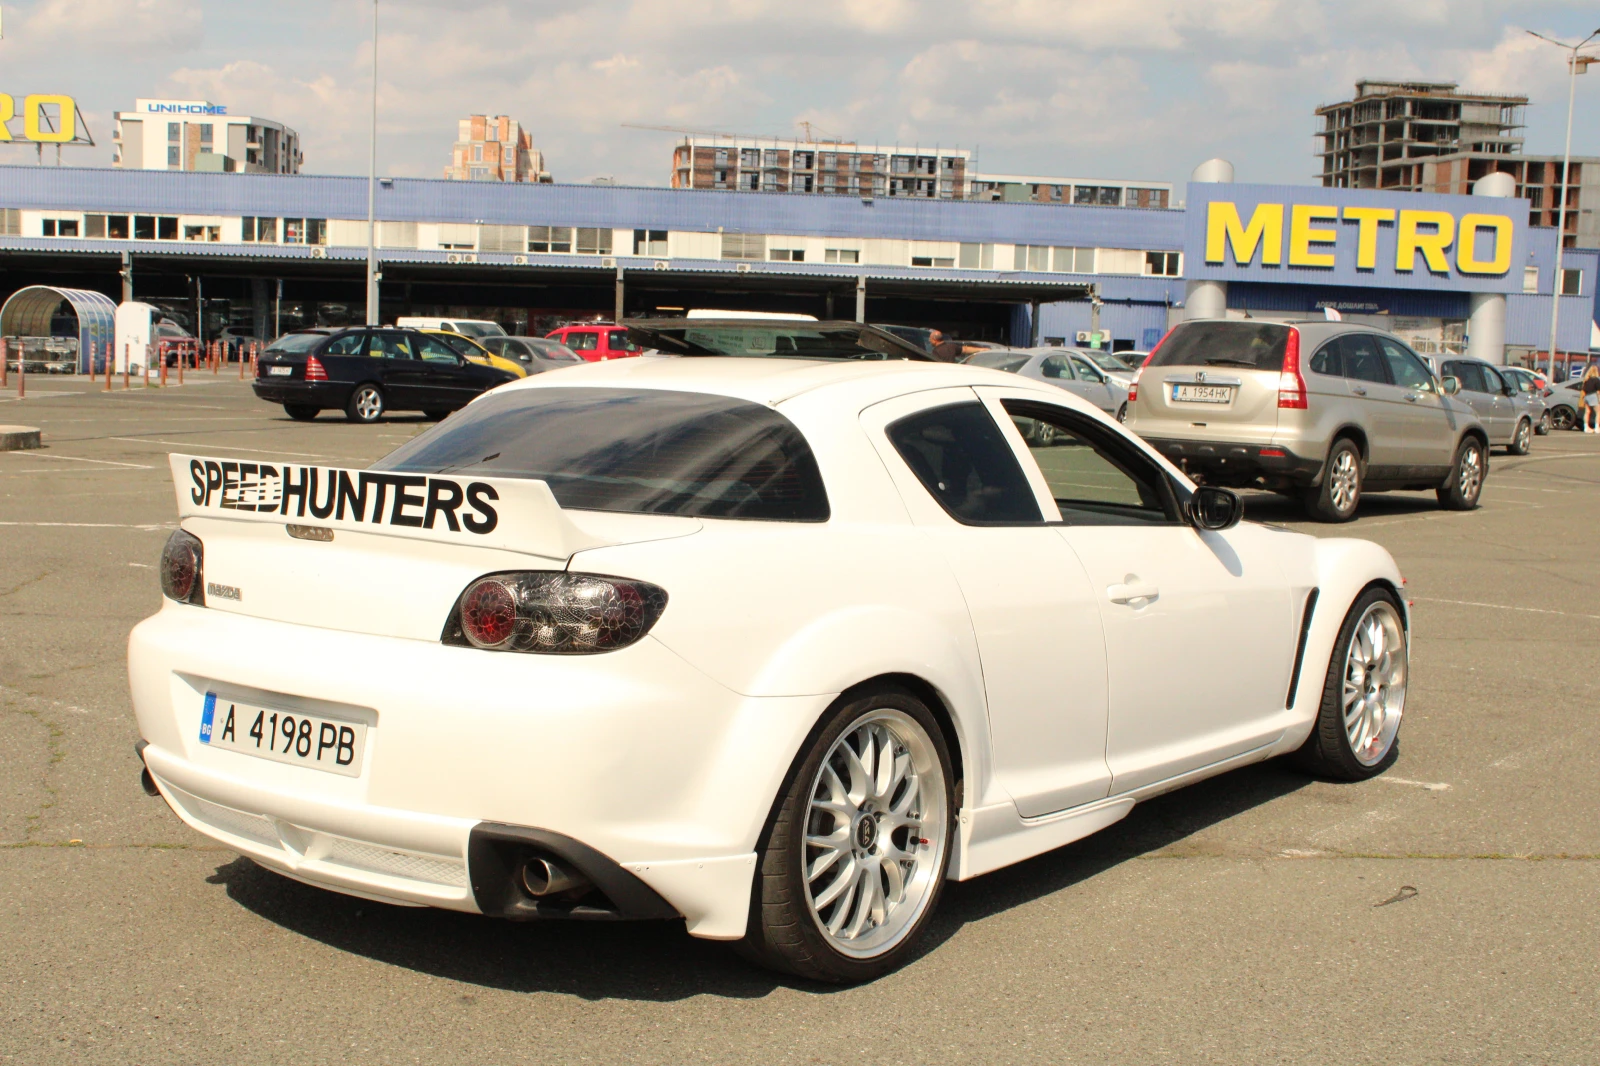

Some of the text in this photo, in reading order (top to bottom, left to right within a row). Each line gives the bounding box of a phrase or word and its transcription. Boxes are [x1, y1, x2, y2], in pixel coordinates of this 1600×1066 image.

[0, 92, 76, 142] O
[148, 103, 227, 115] UNIHOME
[1205, 201, 1514, 275] METRO
[1182, 387, 1187, 397] A
[1193, 387, 1214, 398] 1954
[1215, 388, 1228, 398] HK
[190, 459, 500, 534] SPEEDHUNTERS
[201, 723, 212, 735] BG
[221, 704, 355, 765] A 4198 PB
